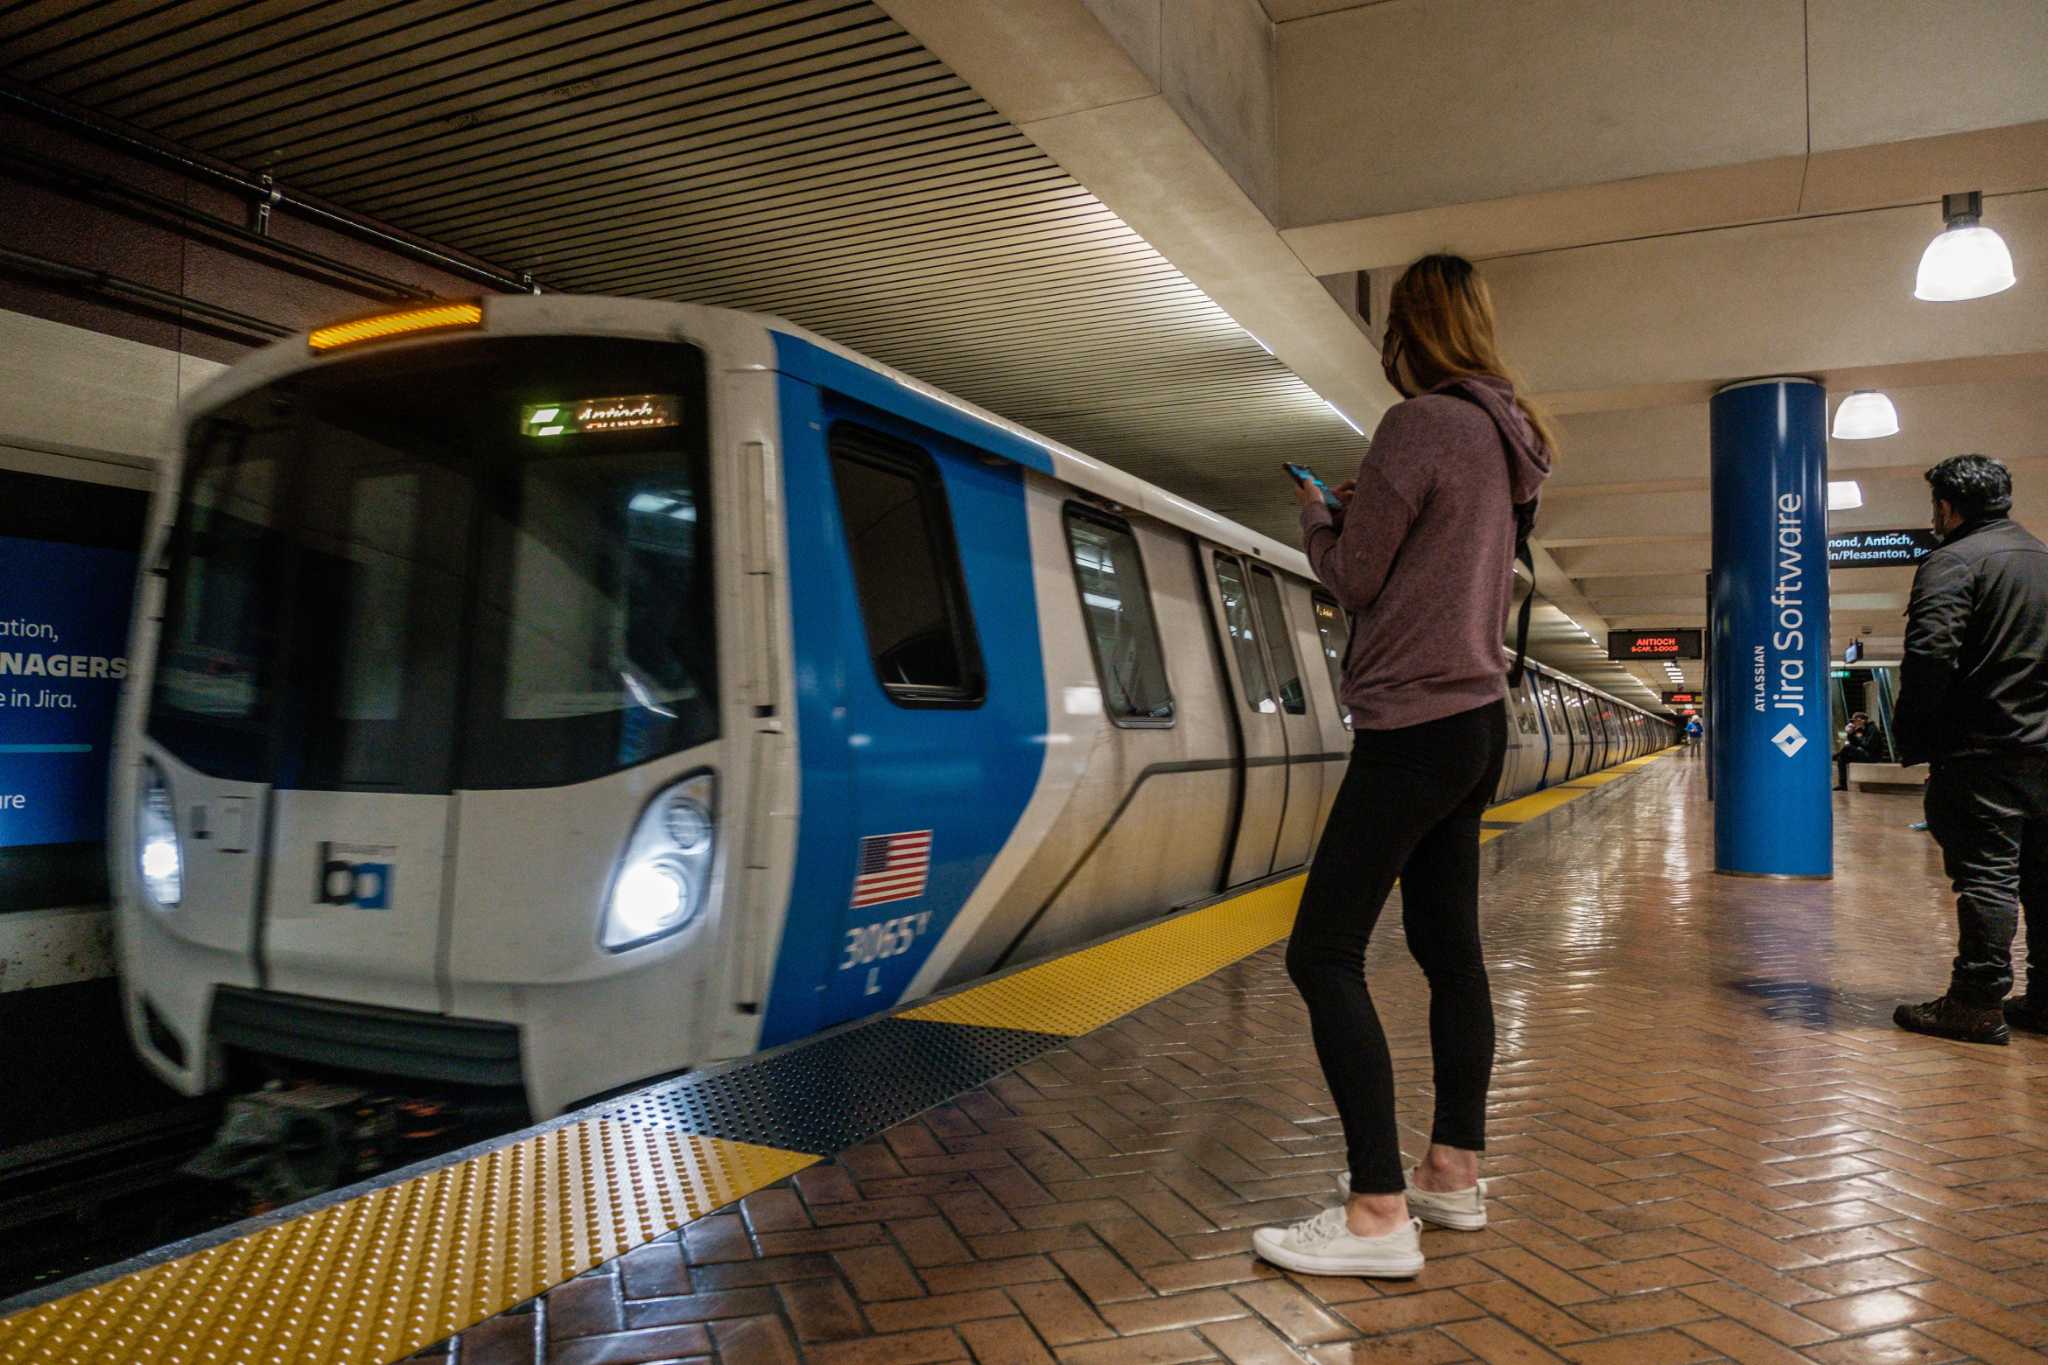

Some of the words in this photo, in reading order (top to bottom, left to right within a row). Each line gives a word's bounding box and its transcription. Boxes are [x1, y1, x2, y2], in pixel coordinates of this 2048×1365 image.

[1864, 534, 1914, 547] Antioch,
[1771, 493, 1803, 651] Software
[1635, 638, 1677, 646] ANTIOCH
[1754, 645, 1766, 712] ATLASSIAN
[1772, 659, 1804, 716] Jira
[11, 688, 30, 707] in
[34, 689, 77, 708] Jira.
